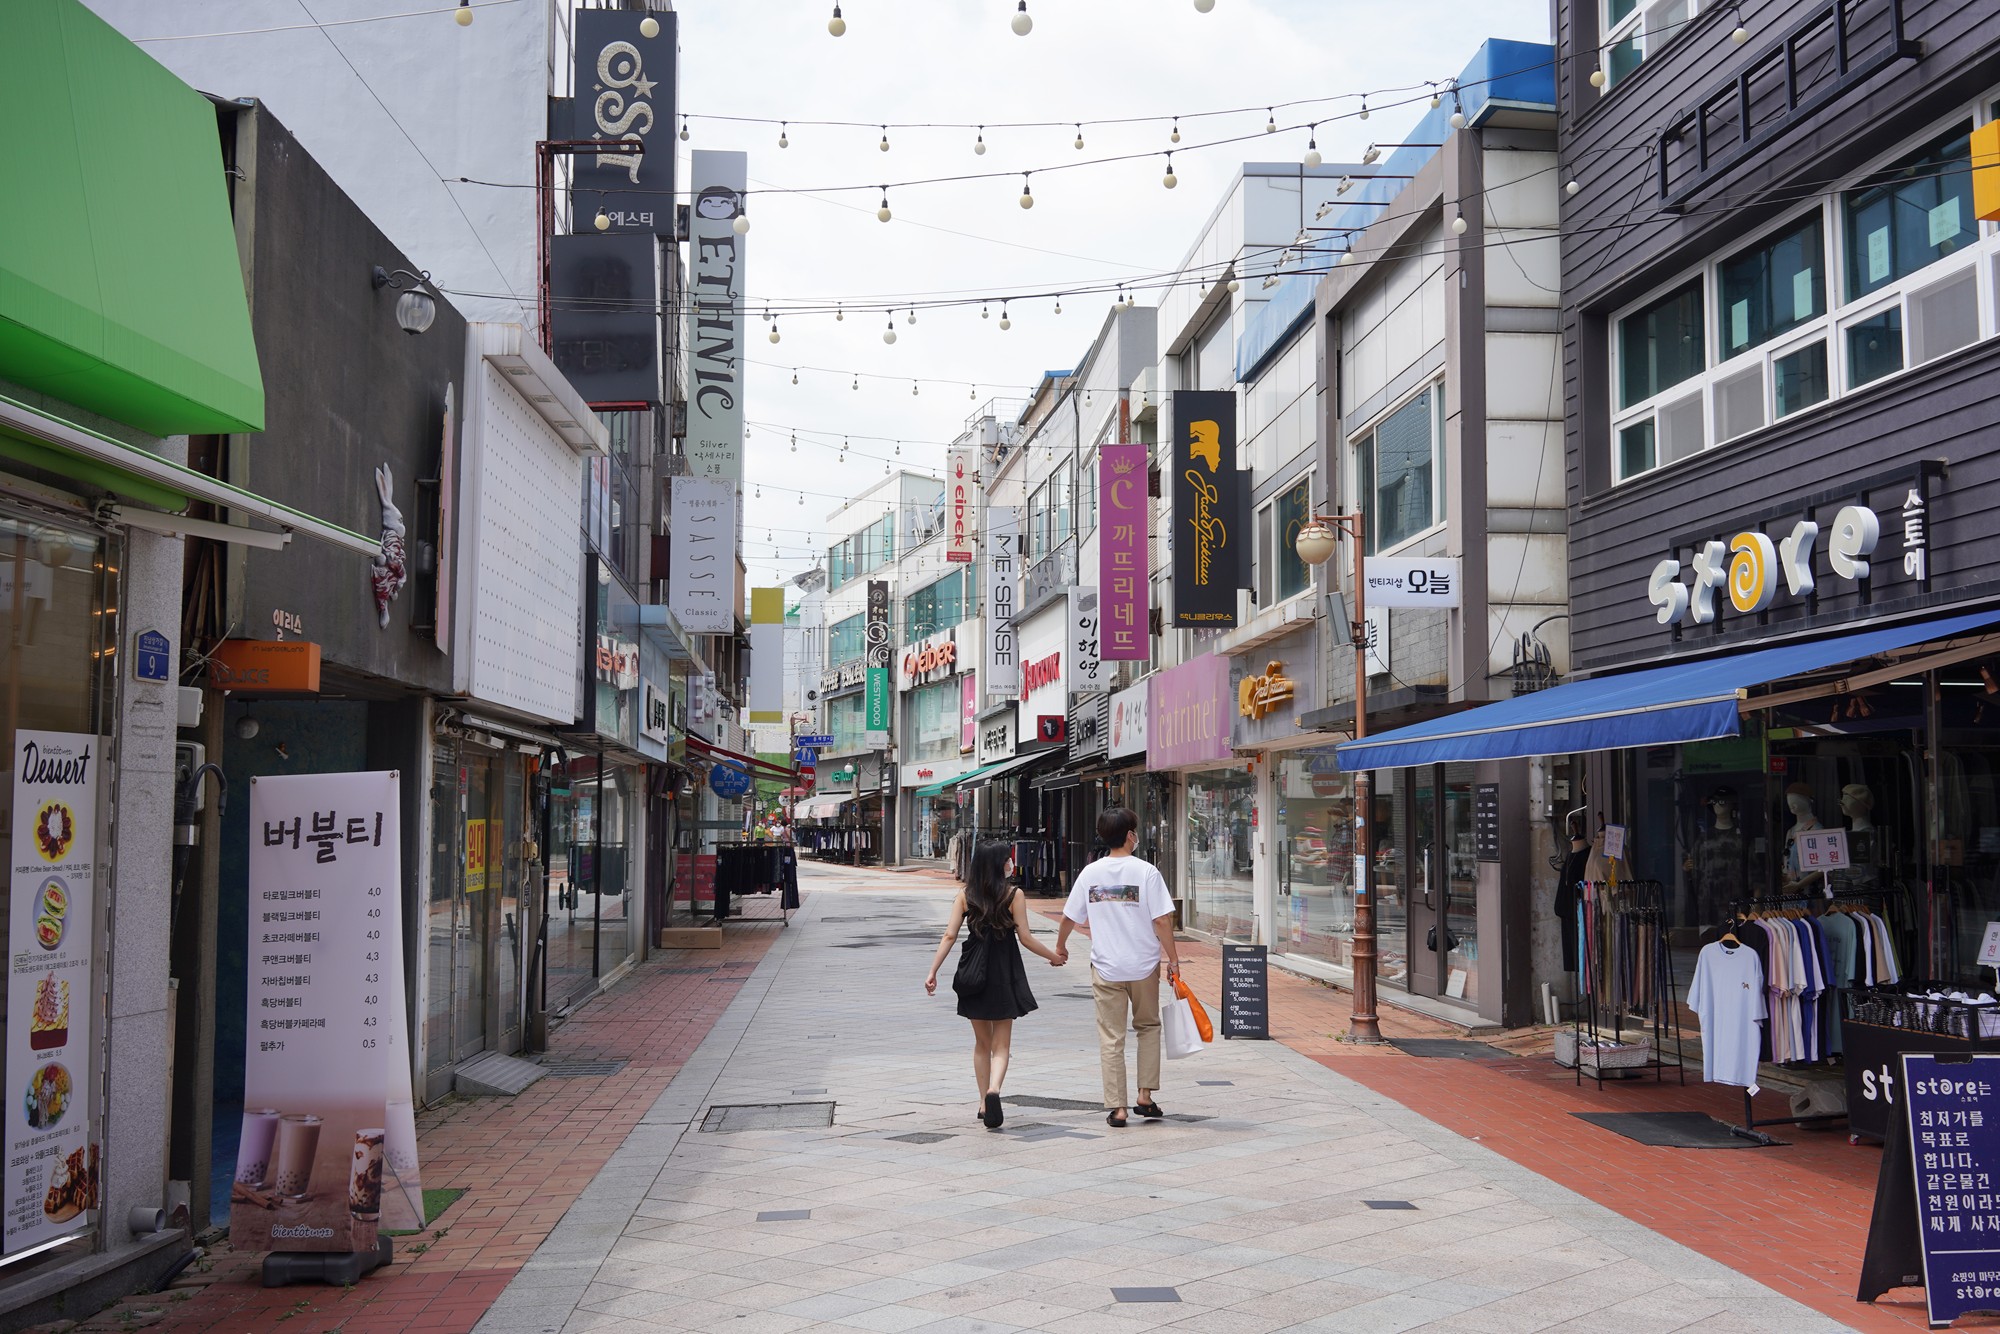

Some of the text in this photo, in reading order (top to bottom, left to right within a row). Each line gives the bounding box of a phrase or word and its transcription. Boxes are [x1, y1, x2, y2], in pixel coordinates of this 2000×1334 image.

[595, 211, 654, 229] 에스티
[700, 439, 728, 449] Silver
[1902, 488, 1925, 581] 스토어
[1112, 524, 1136, 650] 까뜨리네뜨
[1407, 569, 1451, 595] 오늘
[685, 608, 718, 617] Classic
[149, 655, 156, 676] 9
[873, 673, 881, 726] WESTWOOD
[22, 740, 91, 785] Dessert
[264, 810, 384, 864] 버블티
[468, 823, 485, 868] 임대
[1806, 836, 1838, 849] 대박
[1808, 850, 1840, 865] 만원
[262, 889, 321, 901] 타로밀크버블티
[262, 910, 321, 922] 블랙밀크버블티
[262, 932, 320, 944] 초코라떼버블티
[261, 953, 311, 965] 쿠앤크버블티
[261, 975, 311, 987] 자바칩버블티
[260, 997, 302, 1008] 흑당버블티
[260, 1018, 326, 1030] 흑당버블카페라떼
[260, 1040, 285, 1052] 펄추가
[1920, 1110, 1984, 1127] 최저가를
[1922, 1131, 1970, 1148] 목표로
[1923, 1152, 1979, 1169] 합니다.
[1926, 1173, 1990, 1190] 같은물건
[1930, 1215, 1961, 1233] 싸게
[1951, 1271, 1976, 1283] 쇼핑의
